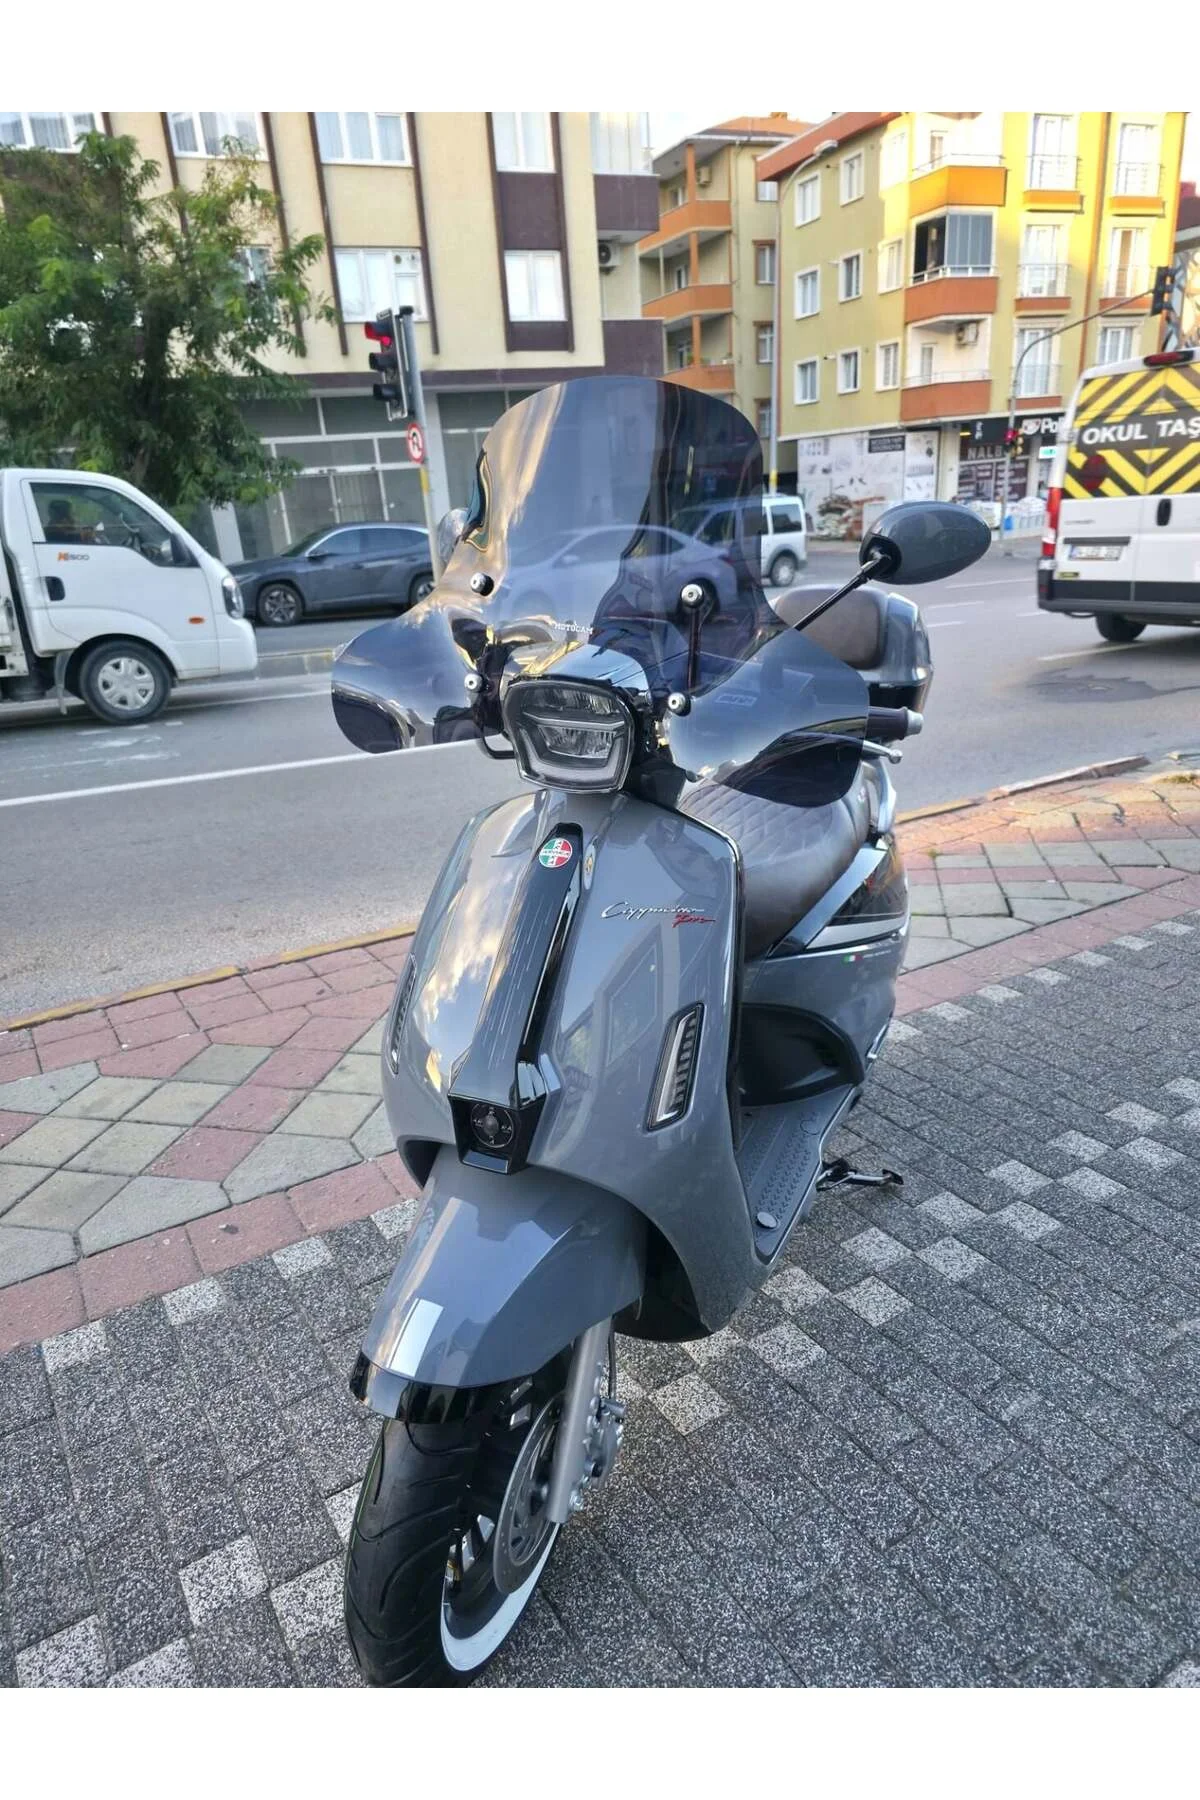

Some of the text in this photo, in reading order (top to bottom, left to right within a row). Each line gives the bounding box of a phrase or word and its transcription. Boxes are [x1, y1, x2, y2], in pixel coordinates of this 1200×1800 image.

[1041, 416, 1066, 434] Pol
[1082, 416, 1200, 445] OKUL TAŞ
[554, 622, 594, 635] MOTOCAM
